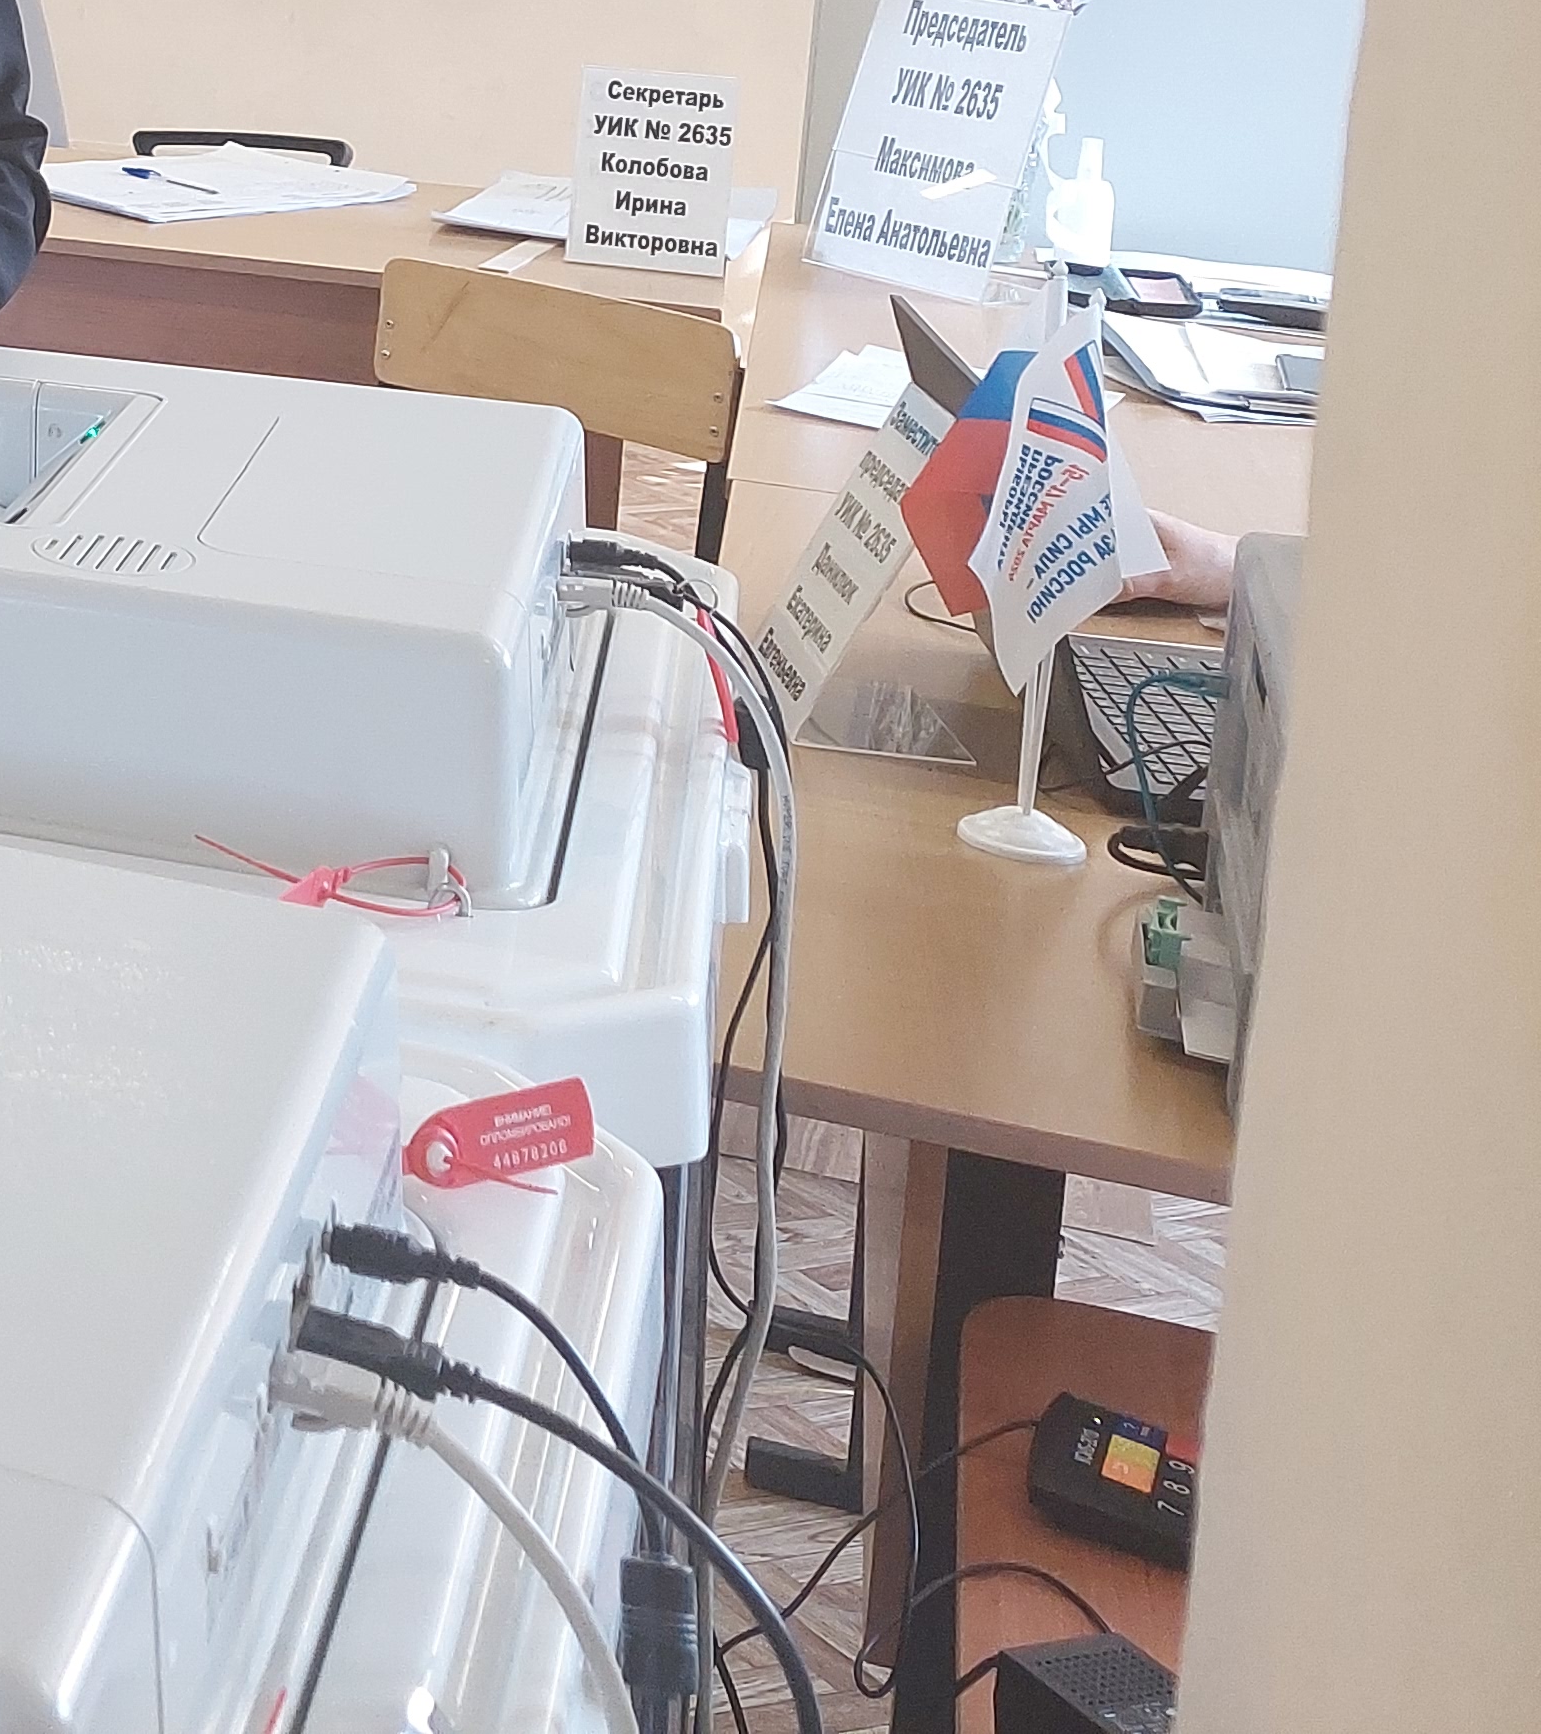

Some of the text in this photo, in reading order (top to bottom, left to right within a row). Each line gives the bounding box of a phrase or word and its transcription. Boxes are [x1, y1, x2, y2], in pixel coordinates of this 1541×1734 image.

[607, 79, 725, 113] Секретарь
[890, 67, 1005, 121] УИК № 2635
[593, 114, 733, 147] УИК № 2635
[600, 150, 709, 182] Колобова
[615, 189, 687, 217] Ирина
[585, 223, 718, 258] Викторовна
[823, 196, 993, 270] Елена Анатольевна
[834, 490, 898, 565] УИК № 2635
[785, 584, 833, 655] Екатерина
[758, 626, 807, 702] Евгеньевна
[1167, 1459, 1196, 1475] 9
[1162, 1479, 1191, 1495] 8
